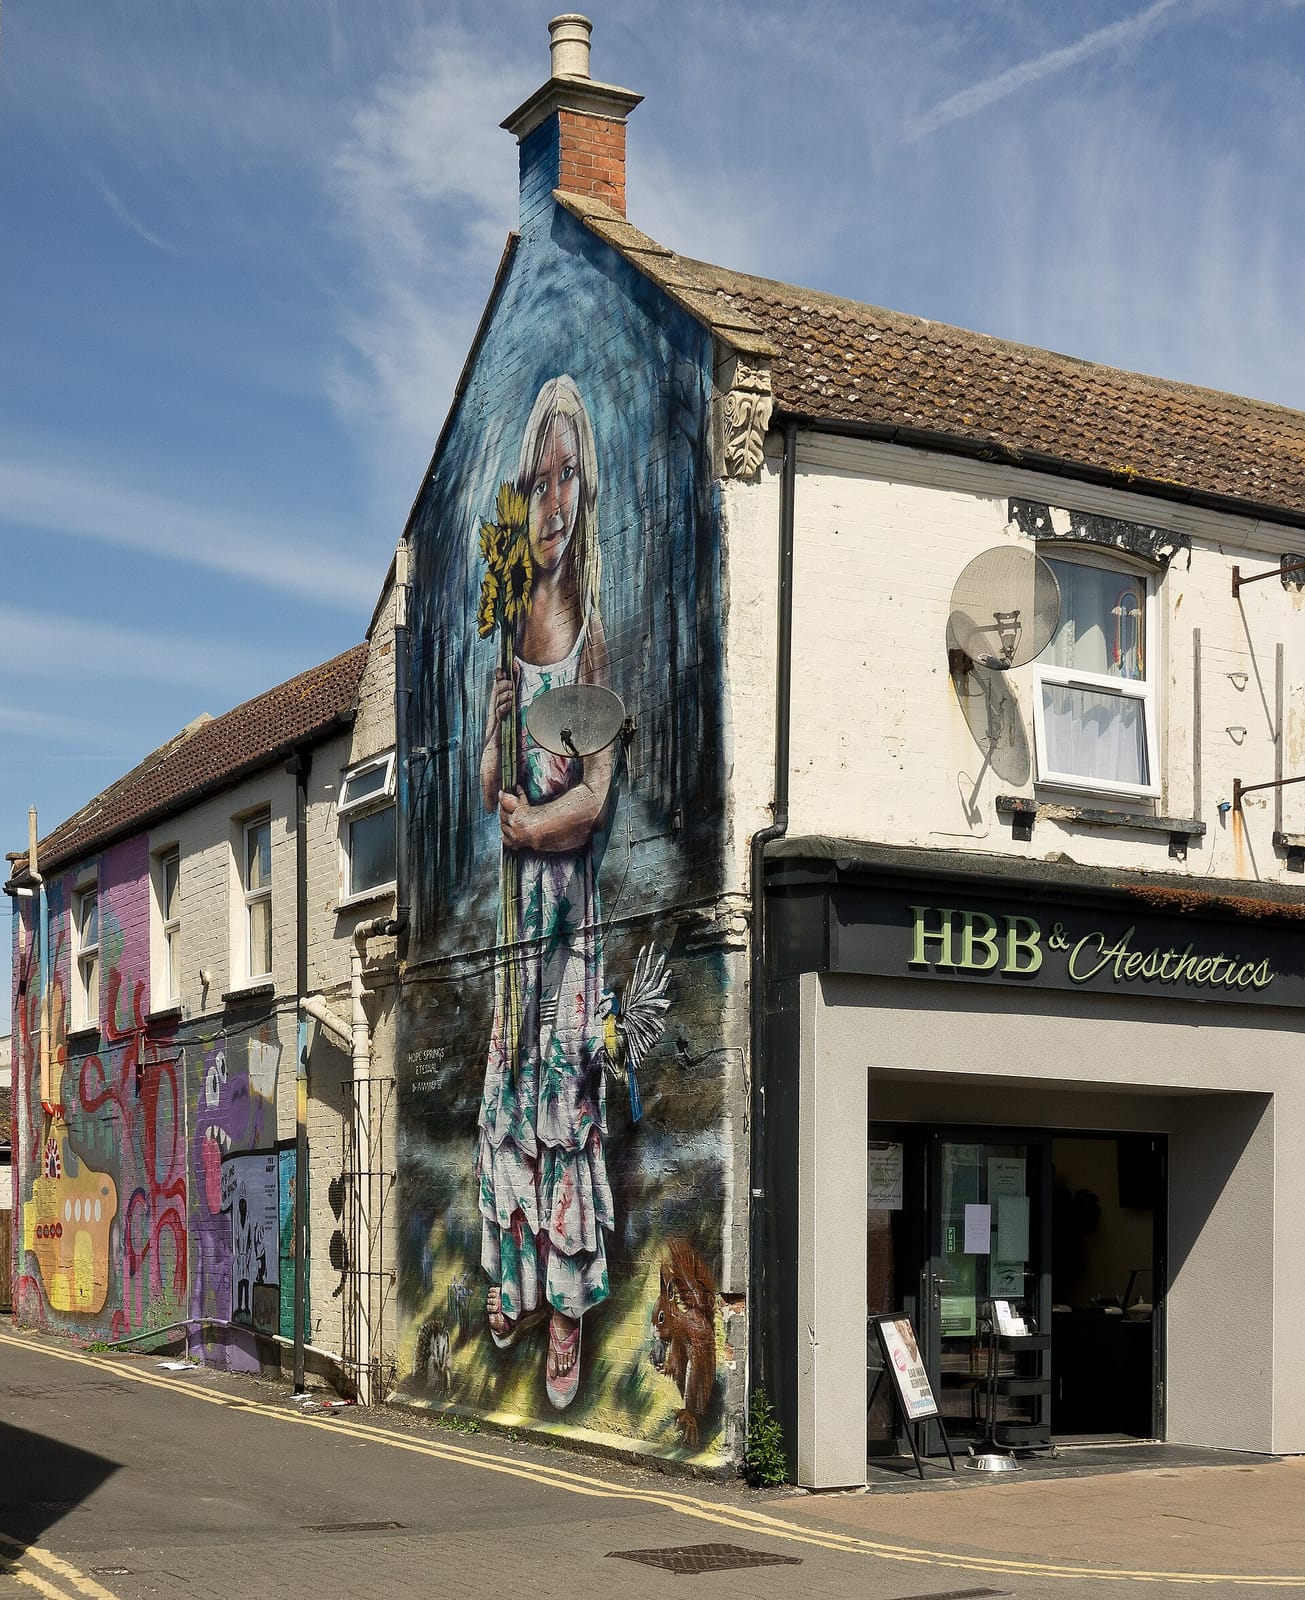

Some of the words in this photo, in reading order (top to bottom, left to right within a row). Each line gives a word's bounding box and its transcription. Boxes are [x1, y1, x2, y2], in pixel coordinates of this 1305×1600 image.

[907, 905, 1044, 974] HBB
[1048, 922, 1070, 951] &
[1068, 926, 1275, 988] Aesthetics
[408, 1051, 422, 1063] HOPE
